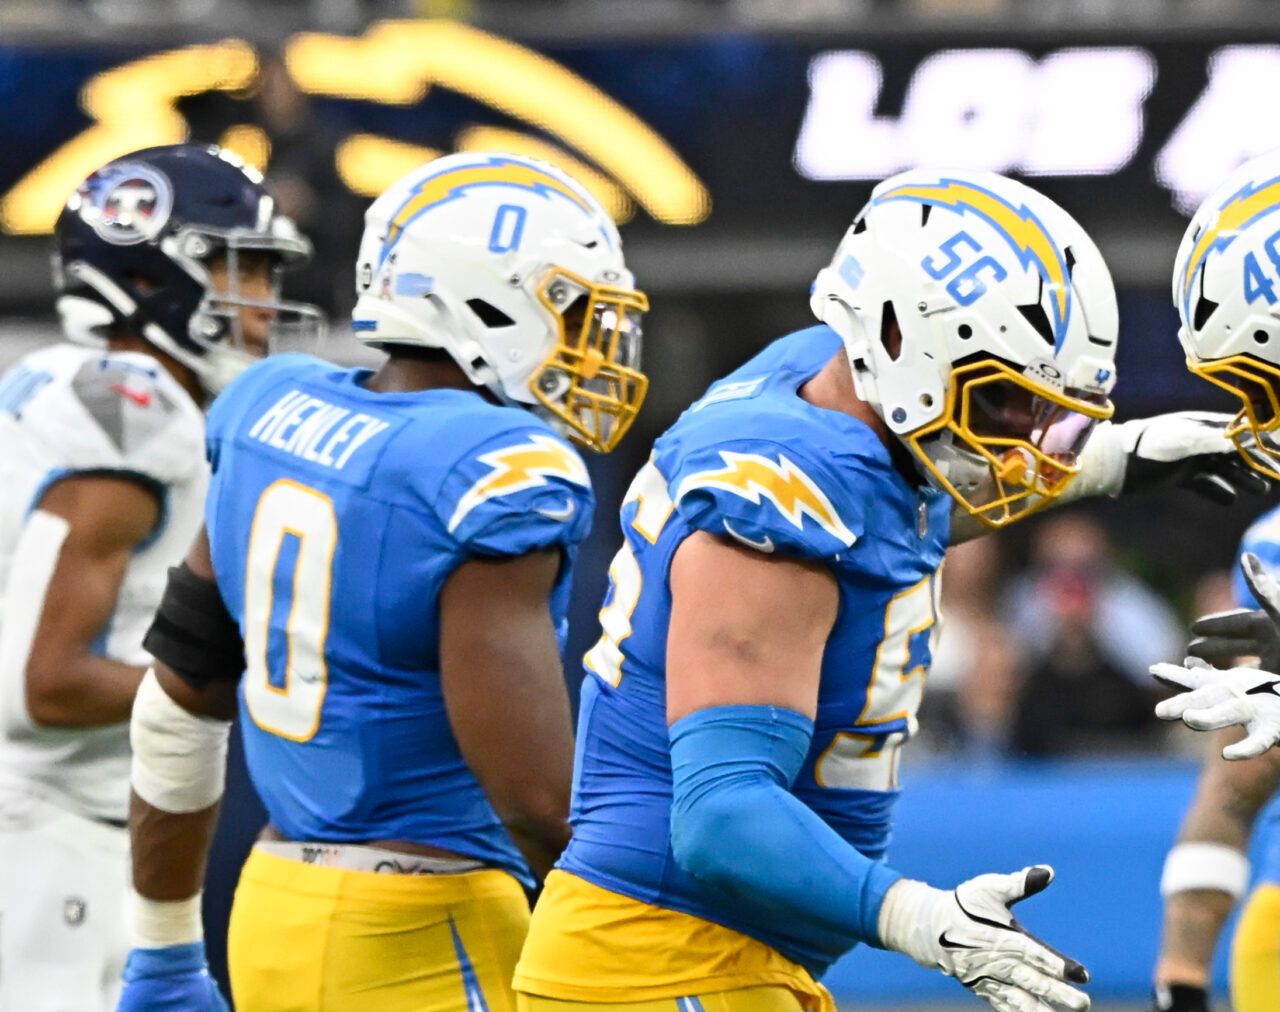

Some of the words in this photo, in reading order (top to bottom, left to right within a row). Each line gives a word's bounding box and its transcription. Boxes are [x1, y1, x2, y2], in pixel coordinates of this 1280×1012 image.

[792, 47, 1158, 180] LOS
[488, 204, 528, 254] 0
[921, 230, 1008, 307] 56
[248, 389, 390, 470] HENLEY
[244, 477, 338, 743] 0
